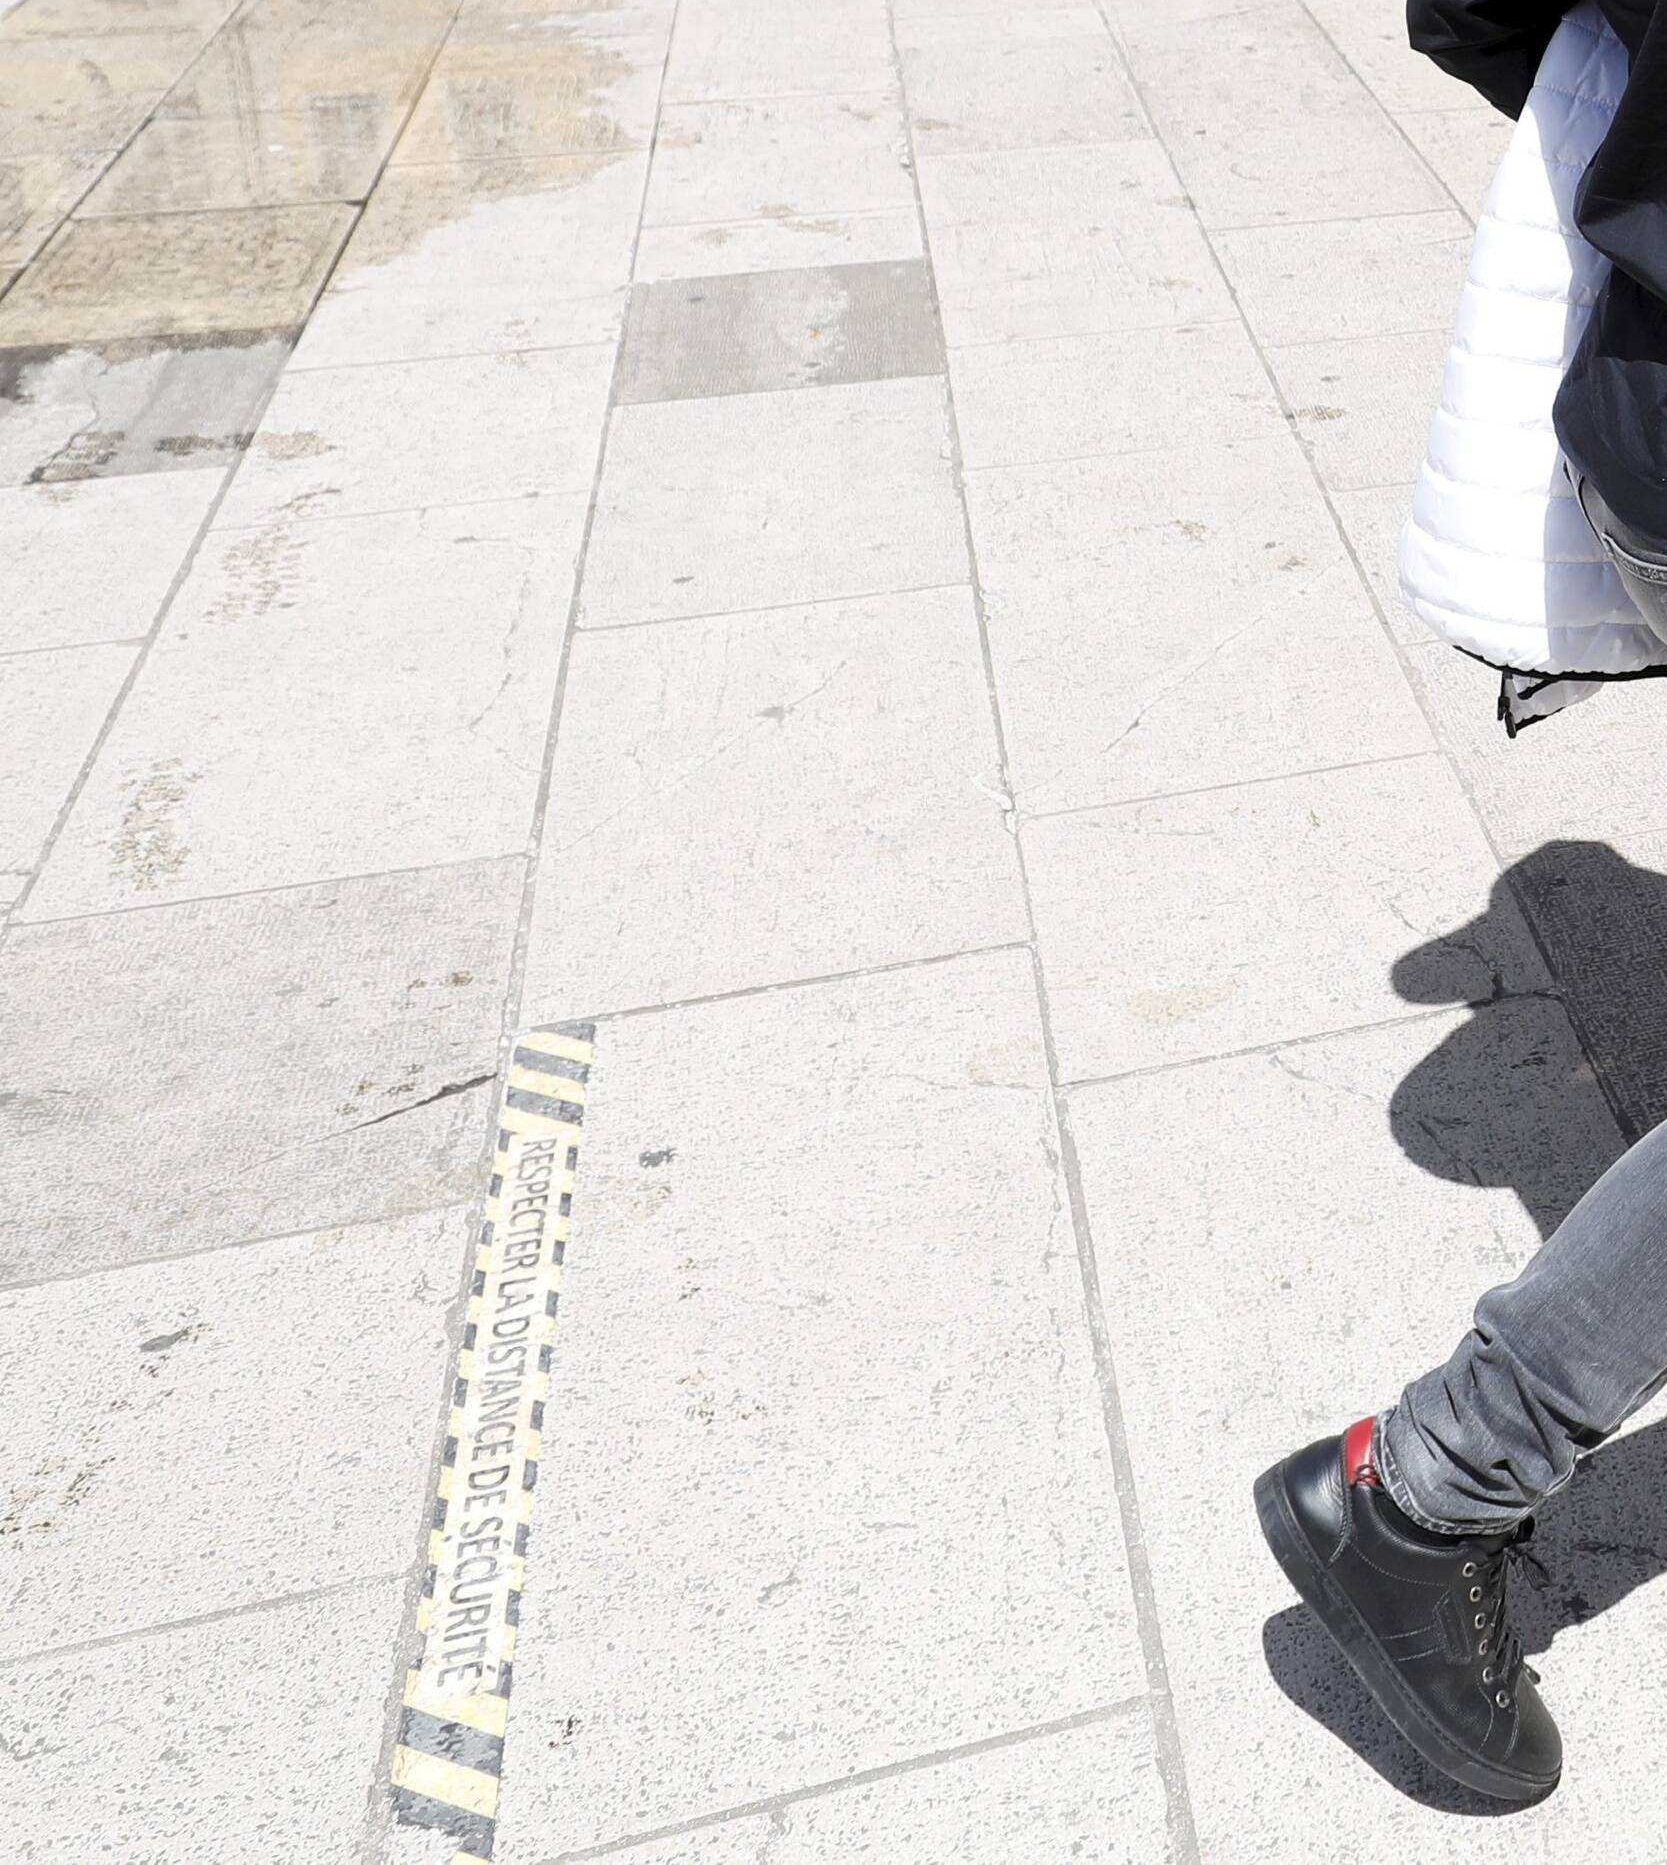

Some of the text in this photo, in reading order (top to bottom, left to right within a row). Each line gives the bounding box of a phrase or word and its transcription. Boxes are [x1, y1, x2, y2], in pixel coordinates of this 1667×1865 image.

[436, 1137, 557, 1689] RESPECTER LA DISTANCE DE SÉCURITÉ
